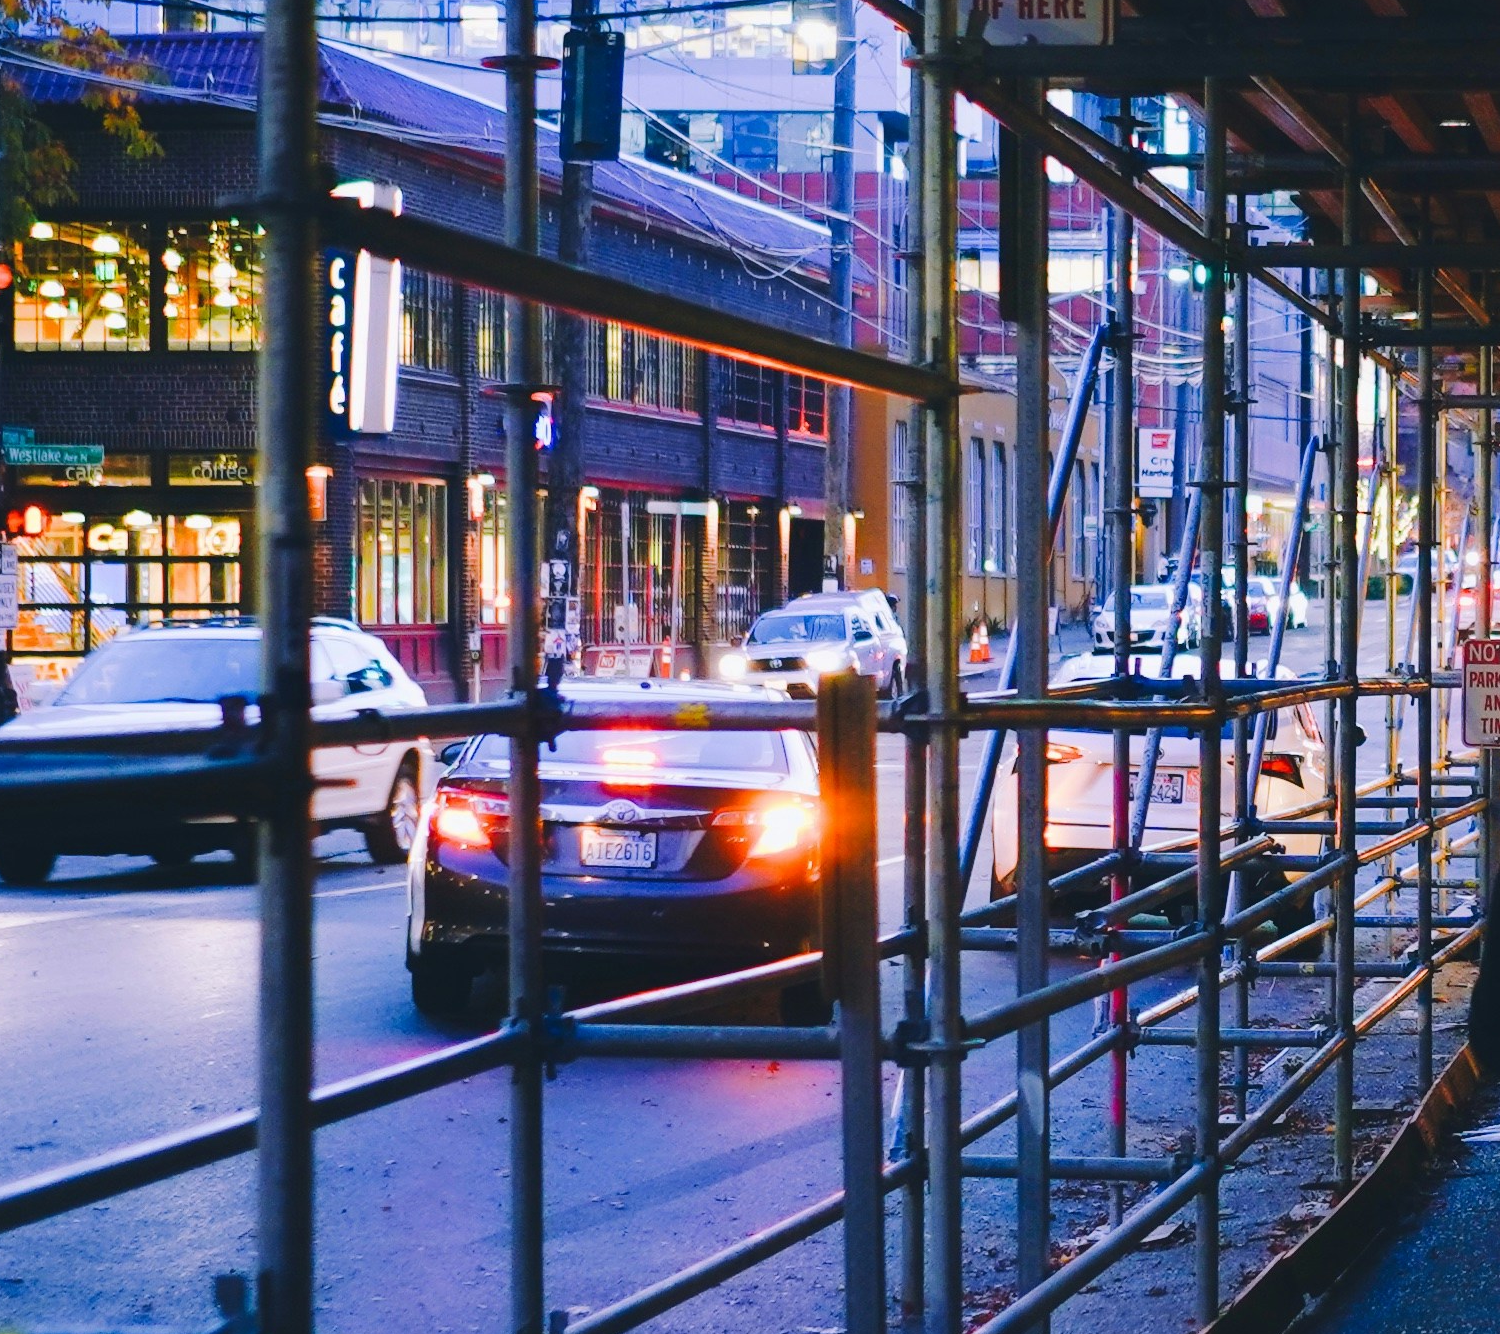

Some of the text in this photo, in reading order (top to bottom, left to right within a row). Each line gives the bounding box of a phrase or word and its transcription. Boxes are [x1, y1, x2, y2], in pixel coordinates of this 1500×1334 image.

[329, 256, 347, 415] café
[9, 447, 62, 464] Westlake
[80, 453, 88, 463] N
[1469, 643, 1496, 662] NO
